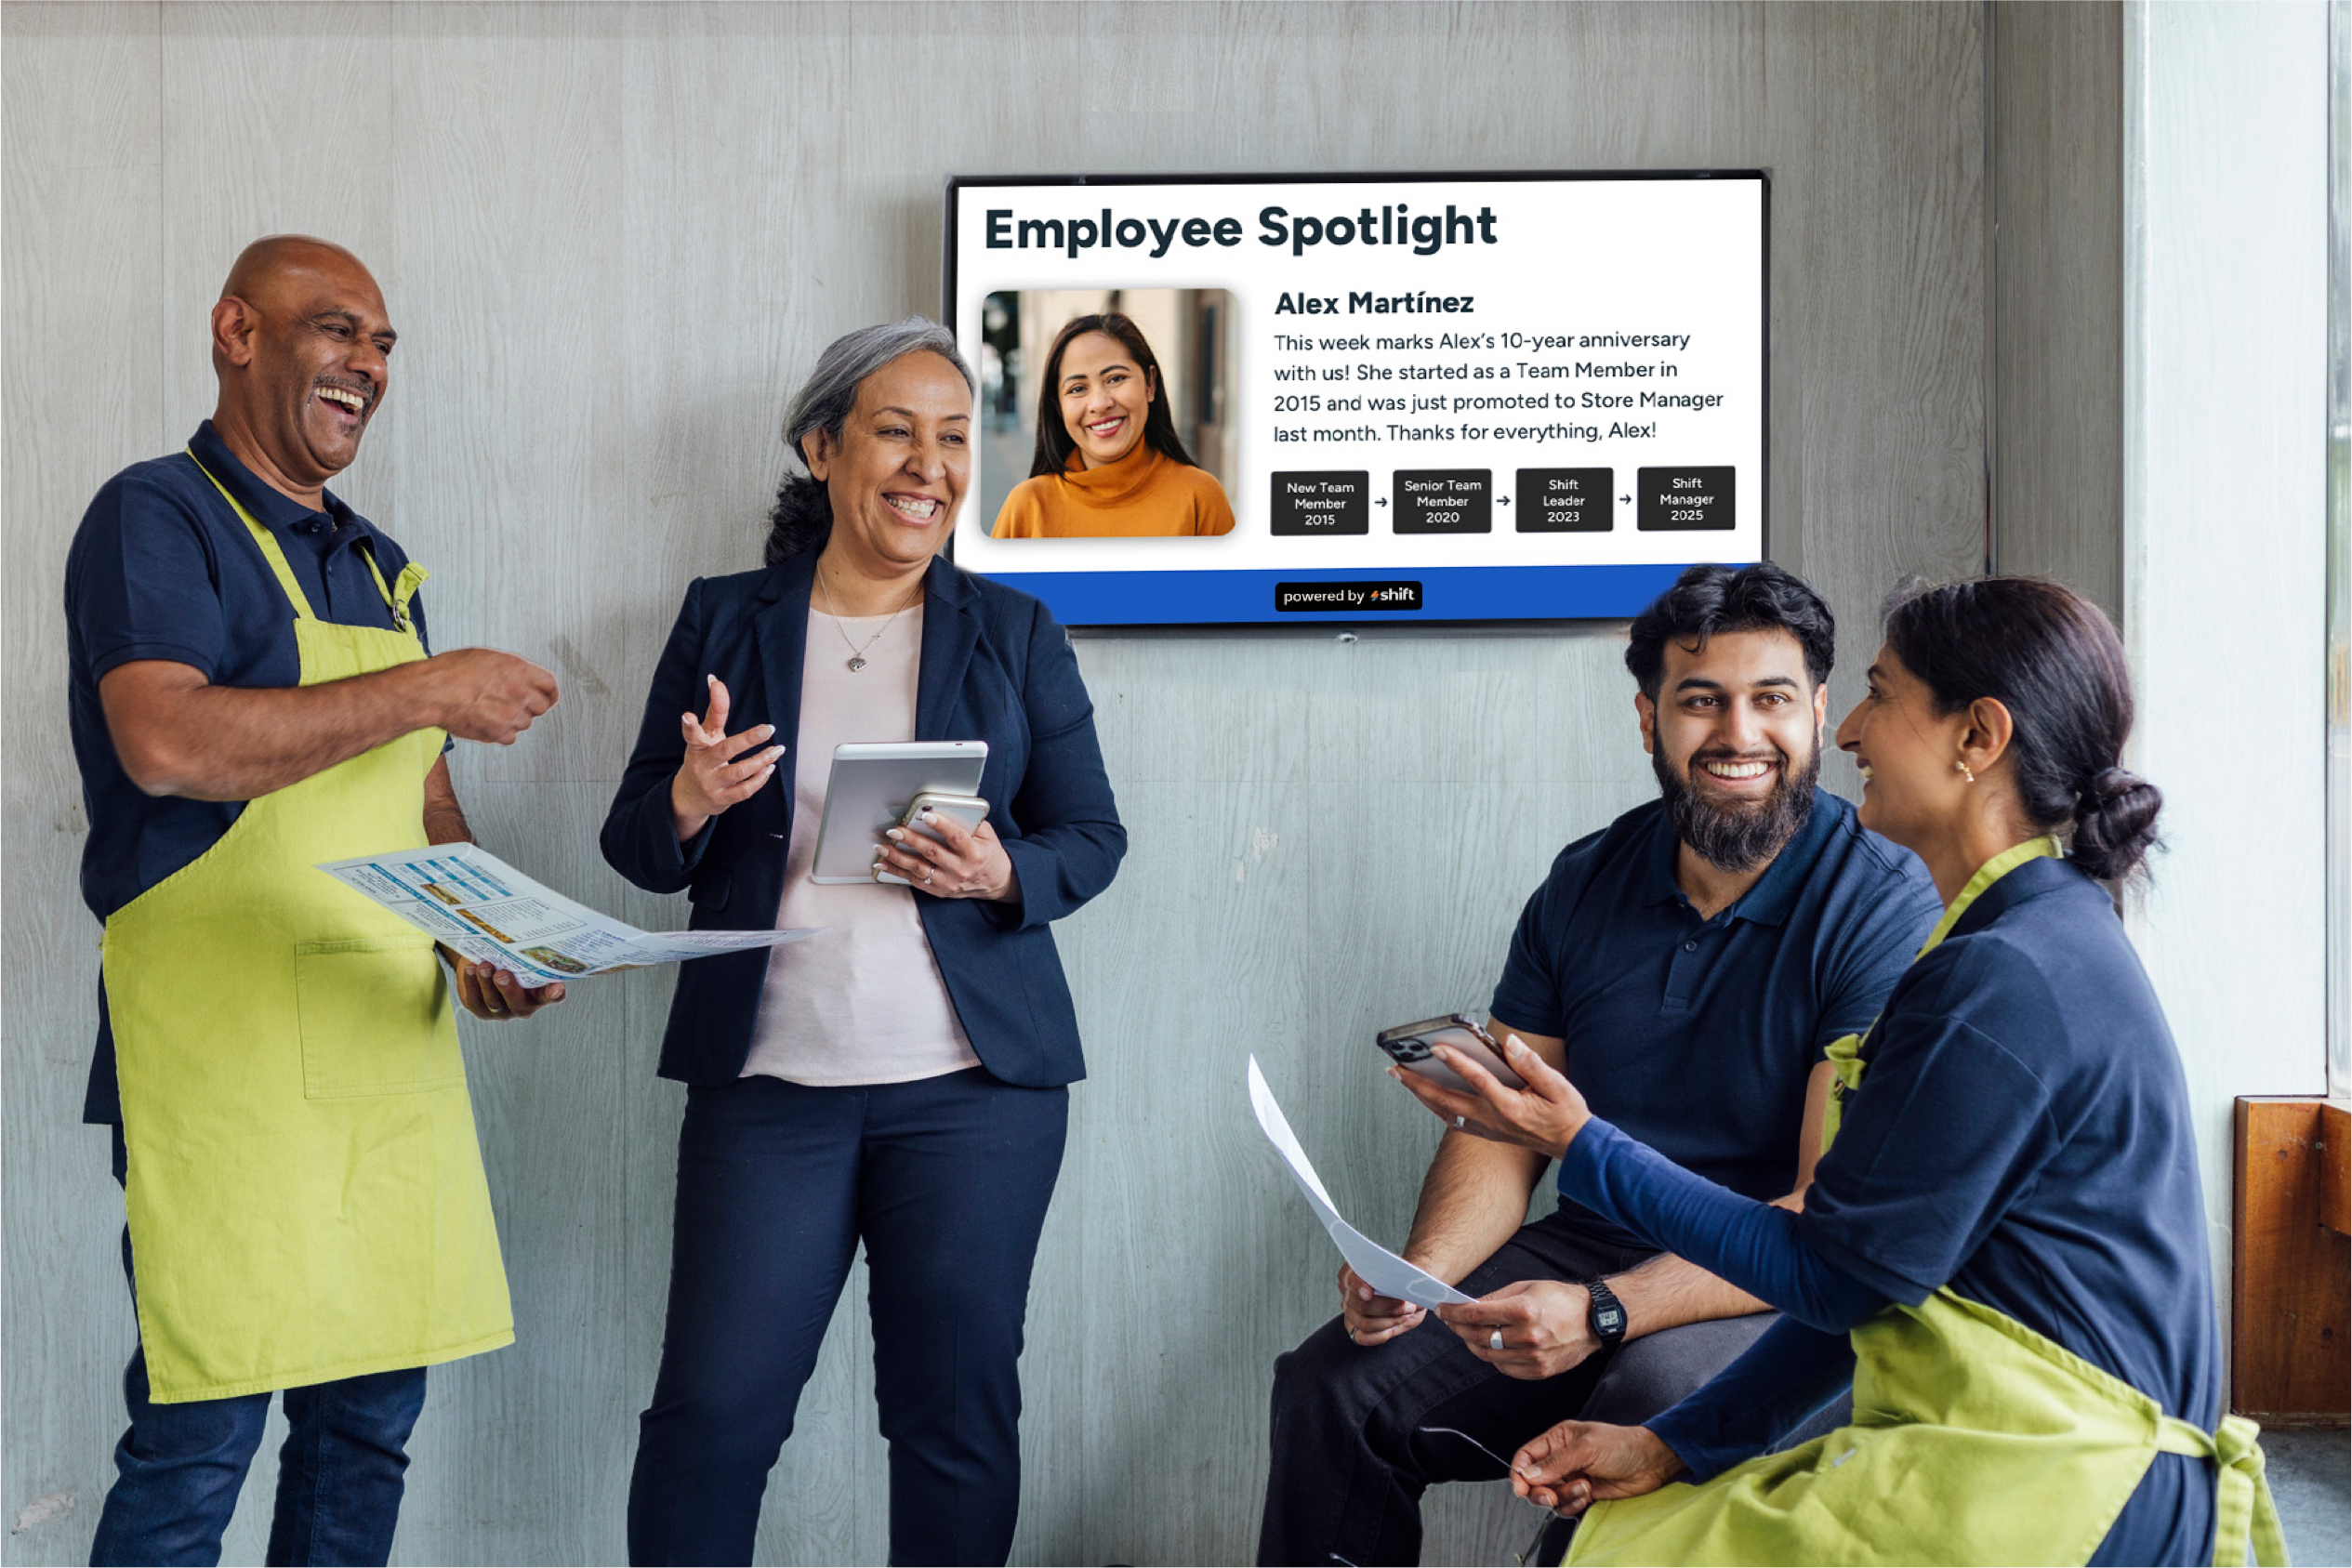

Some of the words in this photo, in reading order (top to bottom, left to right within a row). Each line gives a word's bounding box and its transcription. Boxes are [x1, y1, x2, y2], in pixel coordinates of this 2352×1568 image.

[985, 207, 1243, 259] Employee
[1258, 203, 1499, 257] Spotlight
[1274, 291, 1341, 315] Alex
[1348, 290, 1474, 315] Martínez
[1273, 334, 1314, 351] This
[1318, 334, 1370, 350] week
[1376, 333, 1434, 350] marks
[1439, 332, 1495, 349] Alex’s
[1500, 332, 1576, 353] 10-year
[1579, 331, 1691, 352] anniversary
[1274, 363, 1316, 381] with
[1322, 363, 1350, 381] us!
[1356, 363, 1393, 381] She
[1398, 362, 1468, 380] started
[1473, 366, 1495, 380] as
[1500, 366, 1511, 379] a
[1515, 362, 1569, 379] Team
[1575, 361, 1656, 378] Member
[1660, 360, 1678, 377] in
[1274, 395, 1321, 412] 2015
[1327, 395, 1362, 412] and
[1367, 397, 1407, 411] was
[1409, 393, 1447, 415] just
[1453, 392, 1549, 415] promoted
[1554, 393, 1576, 409] to
[1581, 391, 1634, 409] Store
[1640, 390, 1724, 412] Manager
[1274, 426, 1308, 442] last
[1313, 424, 1381, 442] month.
[1386, 424, 1455, 441] Thanks
[1460, 423, 1489, 441] for
[1493, 421, 1603, 444] everything,
[1607, 421, 1657, 439] Alex!
[1287, 482, 1317, 494] New
[1319, 481, 1354, 494] Team
[1405, 480, 1445, 492] Senior
[1447, 480, 1482, 492] Team
[1549, 479, 1579, 491] Shift
[1672, 477, 1703, 489] Shift
[1295, 497, 1347, 510] Member
[1417, 495, 1470, 507] Member
[1543, 494, 1586, 507] Leader
[1659, 494, 1715, 507] Manager
[1304, 514, 1336, 526] 2015
[1425, 511, 1460, 523] 2020
[1547, 511, 1580, 522] 2023
[1671, 509, 1704, 520] 2025
[1284, 589, 1344, 606] powered
[1347, 589, 1365, 605] by
[1380, 586, 1415, 601] shift
